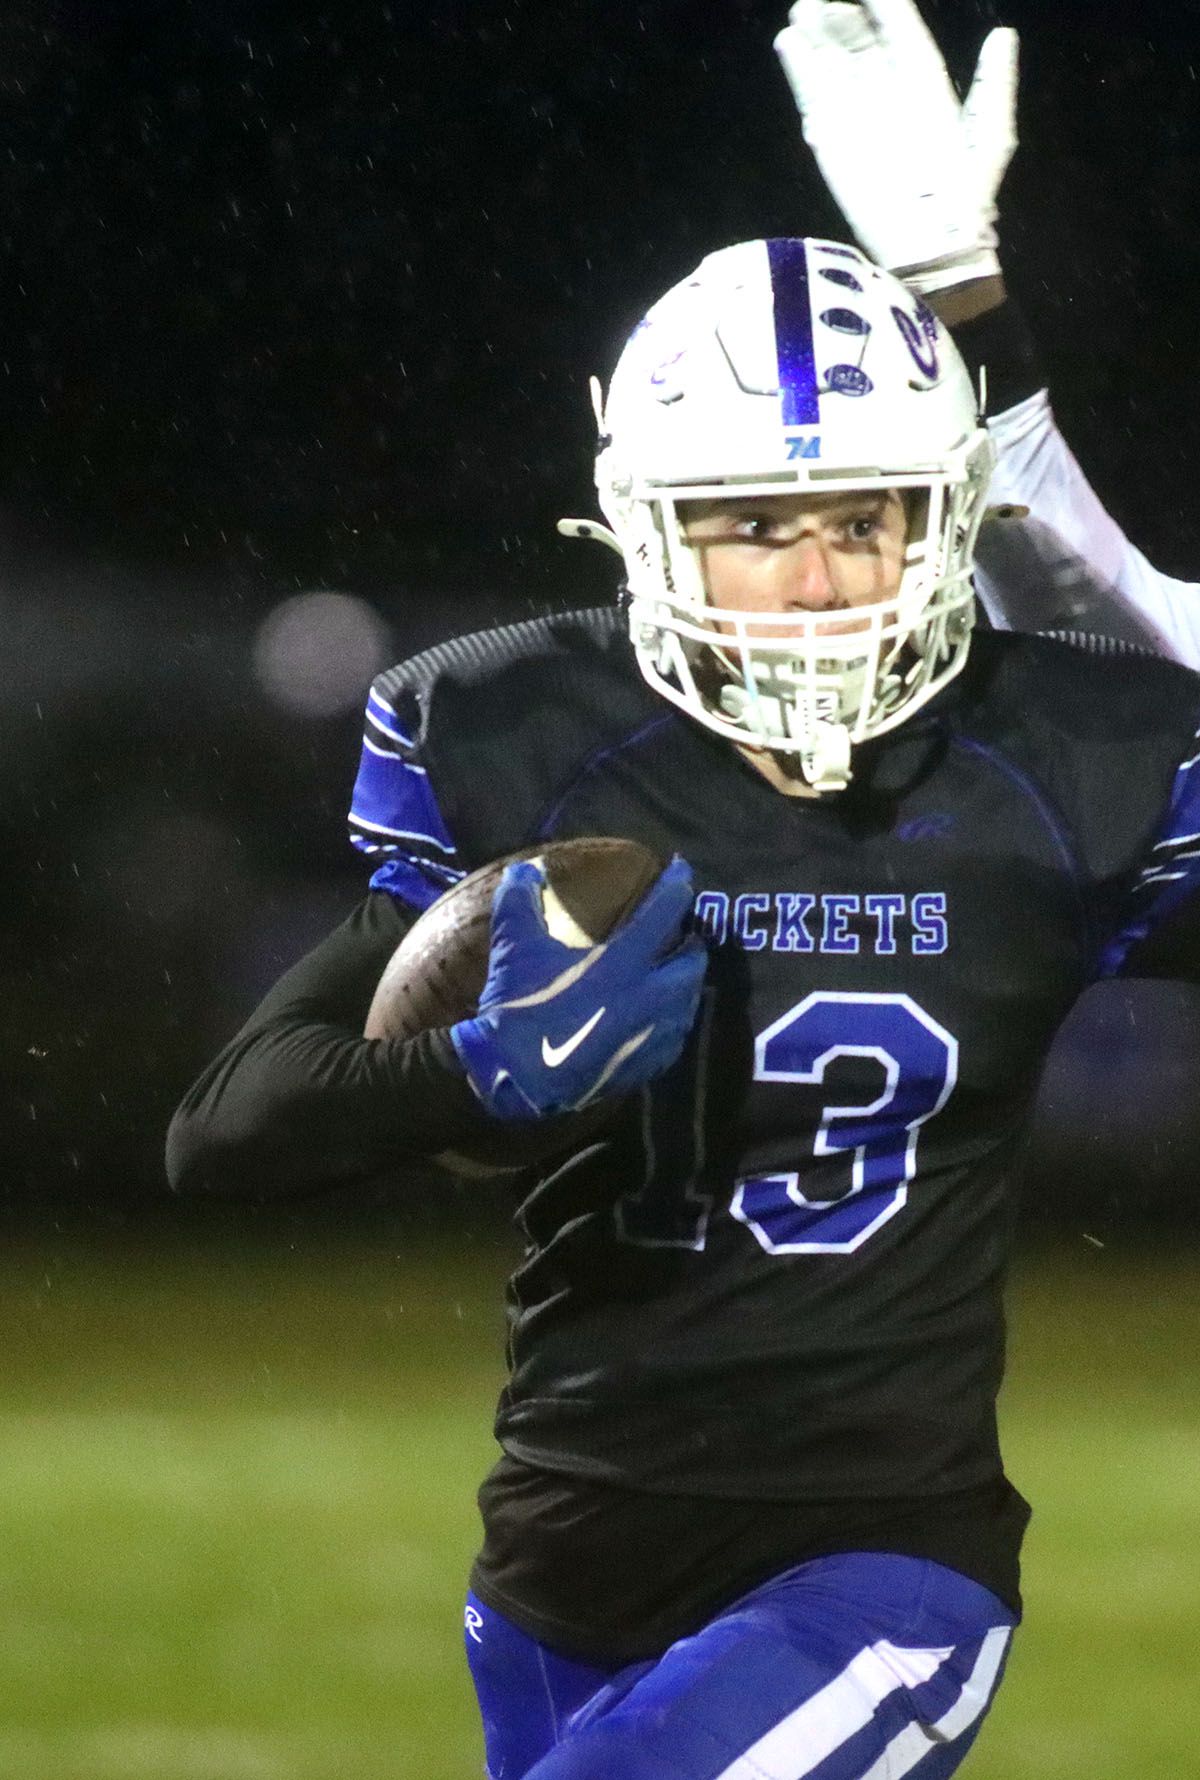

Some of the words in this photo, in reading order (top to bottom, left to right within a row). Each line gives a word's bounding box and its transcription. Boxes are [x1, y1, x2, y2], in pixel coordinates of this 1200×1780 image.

[785, 436, 821, 460] 74
[694, 890, 948, 954] OCKETS
[613, 990, 958, 1255] 13
